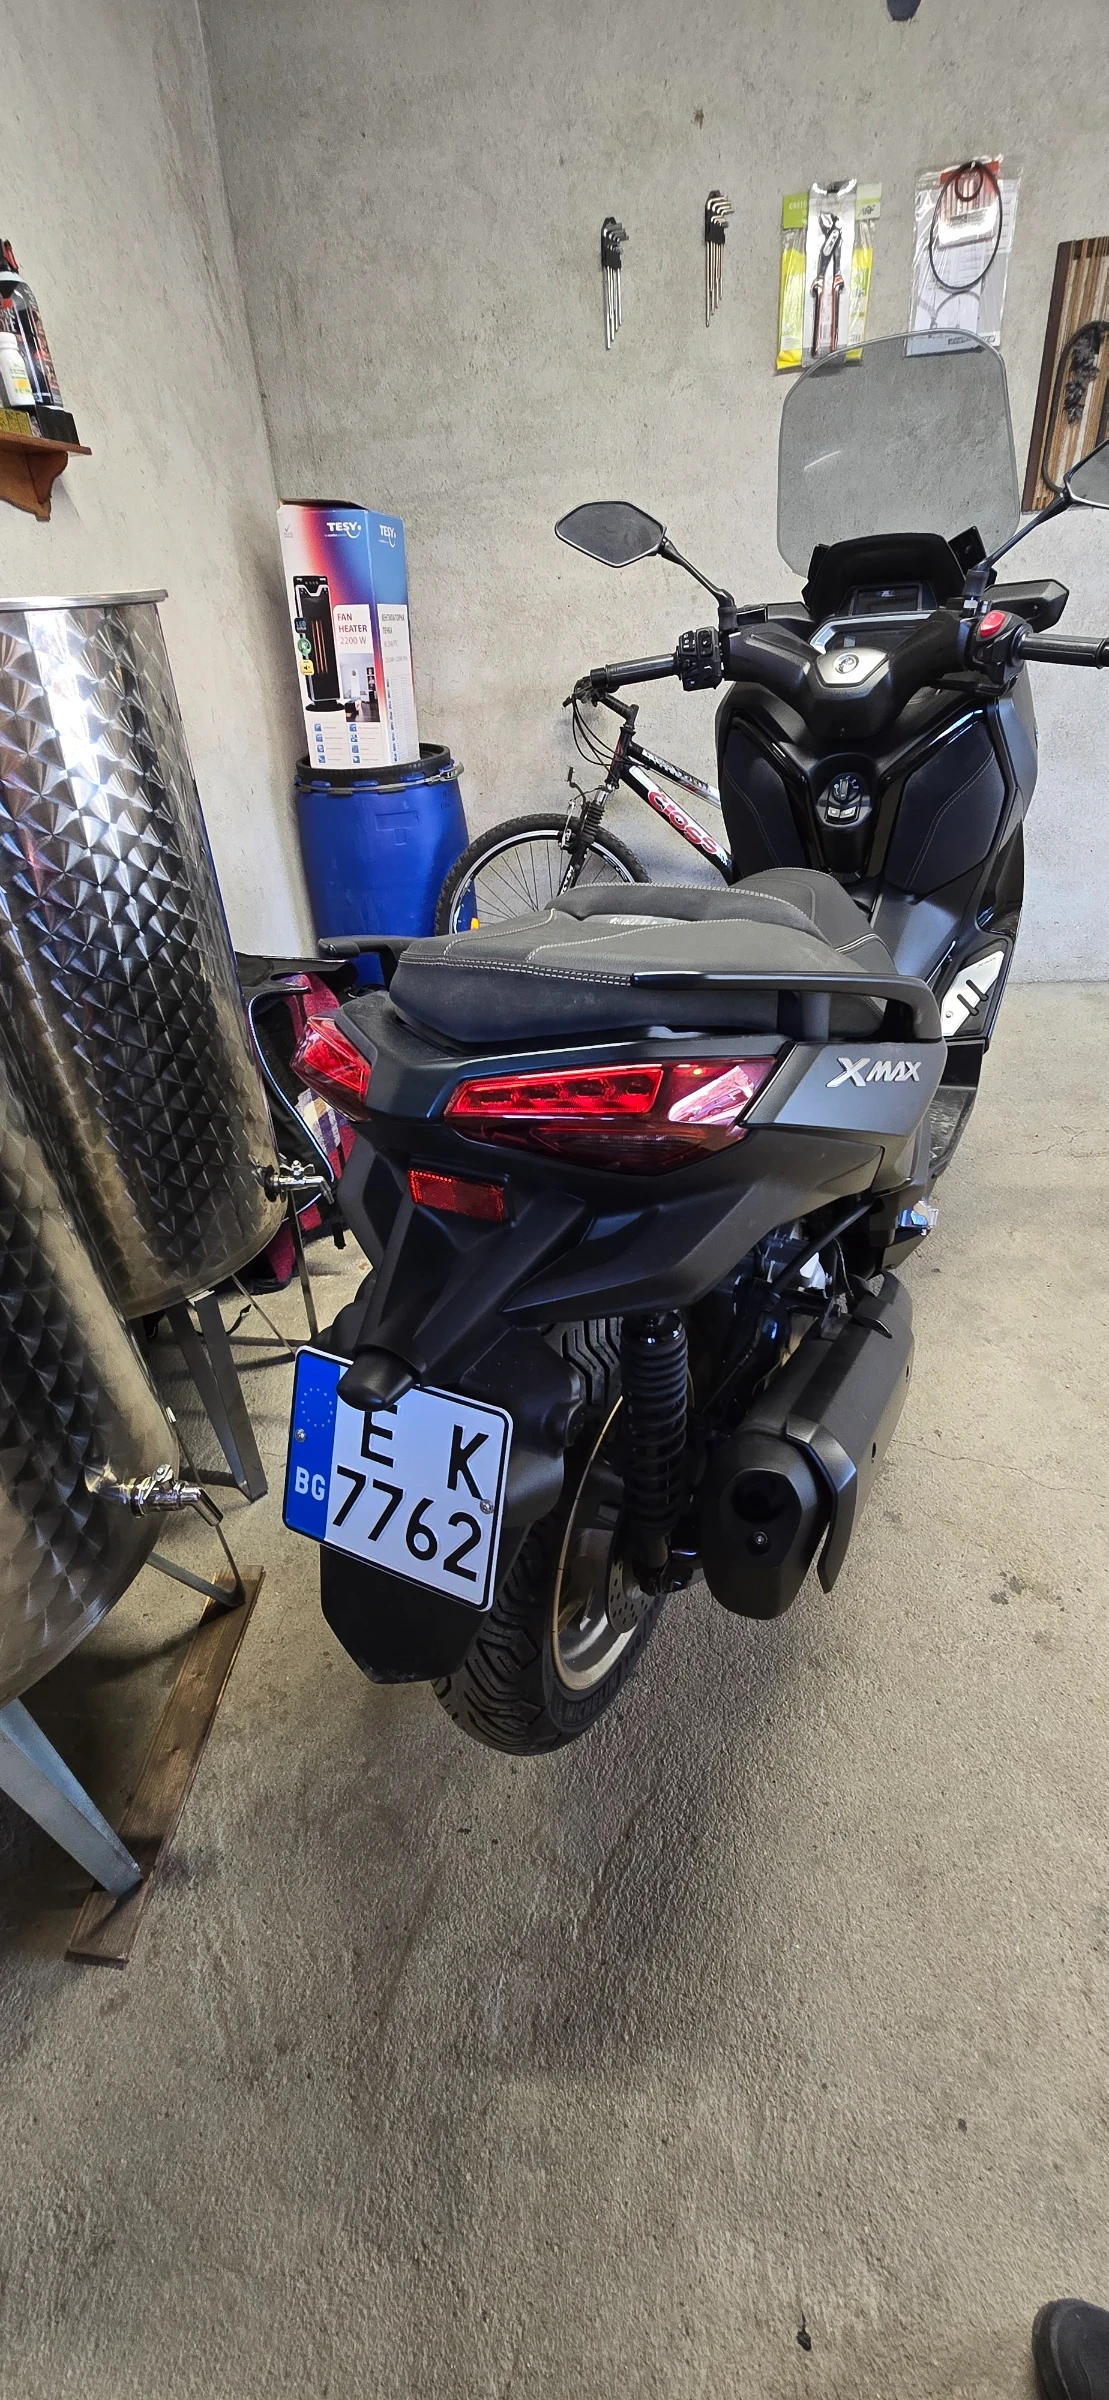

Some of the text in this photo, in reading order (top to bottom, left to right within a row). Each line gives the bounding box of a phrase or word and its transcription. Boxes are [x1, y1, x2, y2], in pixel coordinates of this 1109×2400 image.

[326, 521, 358, 532] TESY
[337, 613, 353, 622] FAN
[338, 624, 368, 633] HEATER
[340, 636, 367, 645] 2200 W
[825, 1057, 922, 1088] XMAX
[360, 1404, 490, 1501] E K
[294, 1466, 326, 1501] BG
[332, 1464, 482, 1582] 7762
